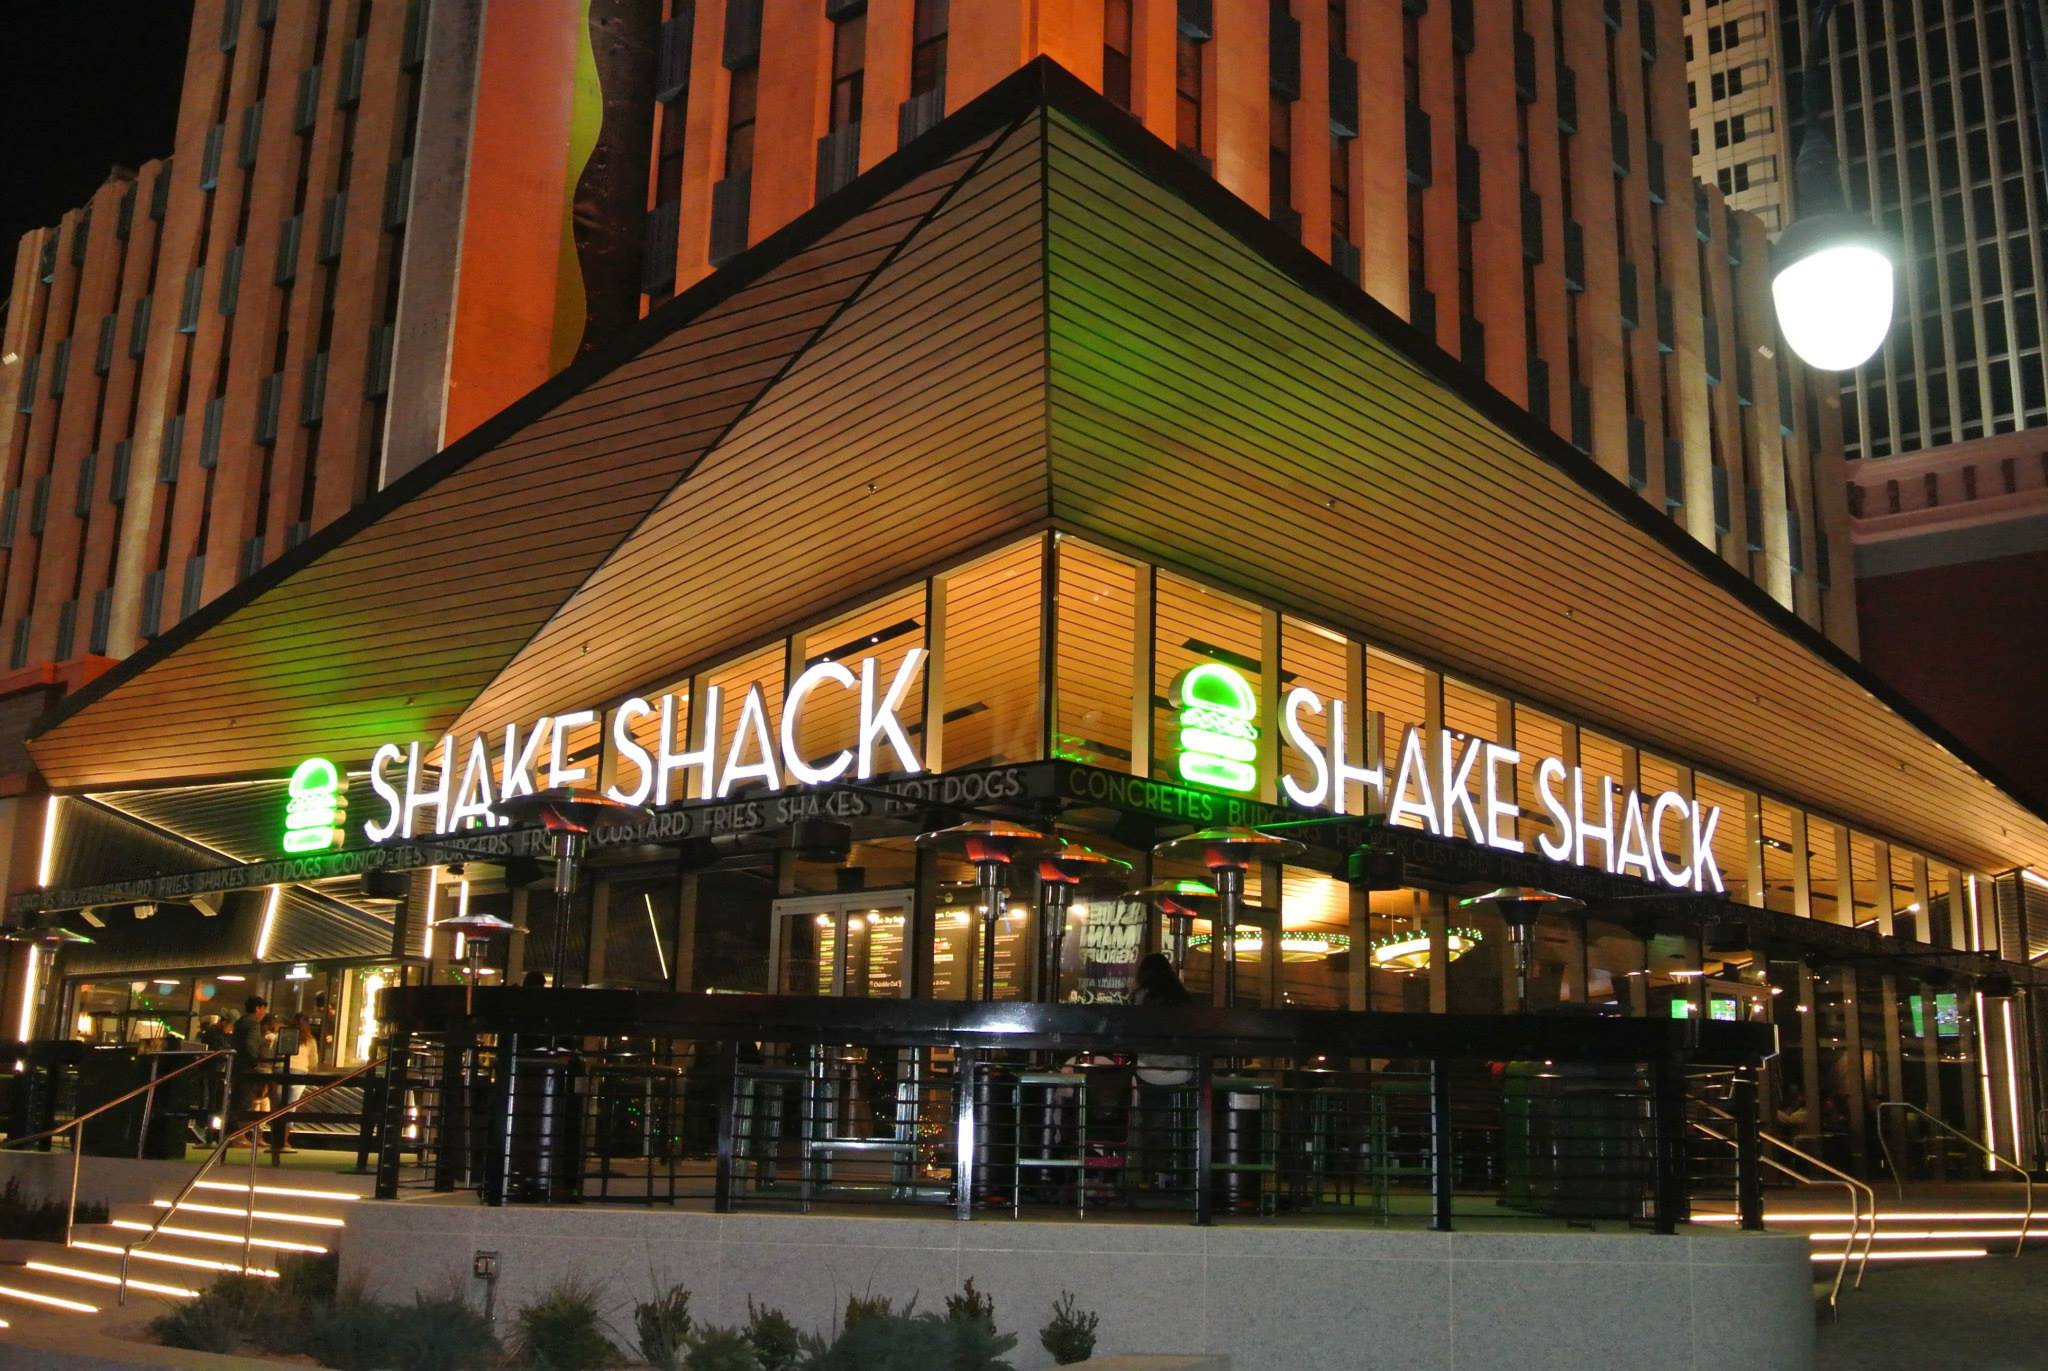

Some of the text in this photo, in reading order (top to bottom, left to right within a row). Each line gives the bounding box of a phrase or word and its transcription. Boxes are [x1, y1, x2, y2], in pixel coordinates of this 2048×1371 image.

[363, 648, 929, 842] SHAKE SHACK
[1069, 766, 1214, 821] CONCRETES
[1277, 687, 1724, 893] SHAKE SHACK
[702, 802, 758, 833] FRIES
